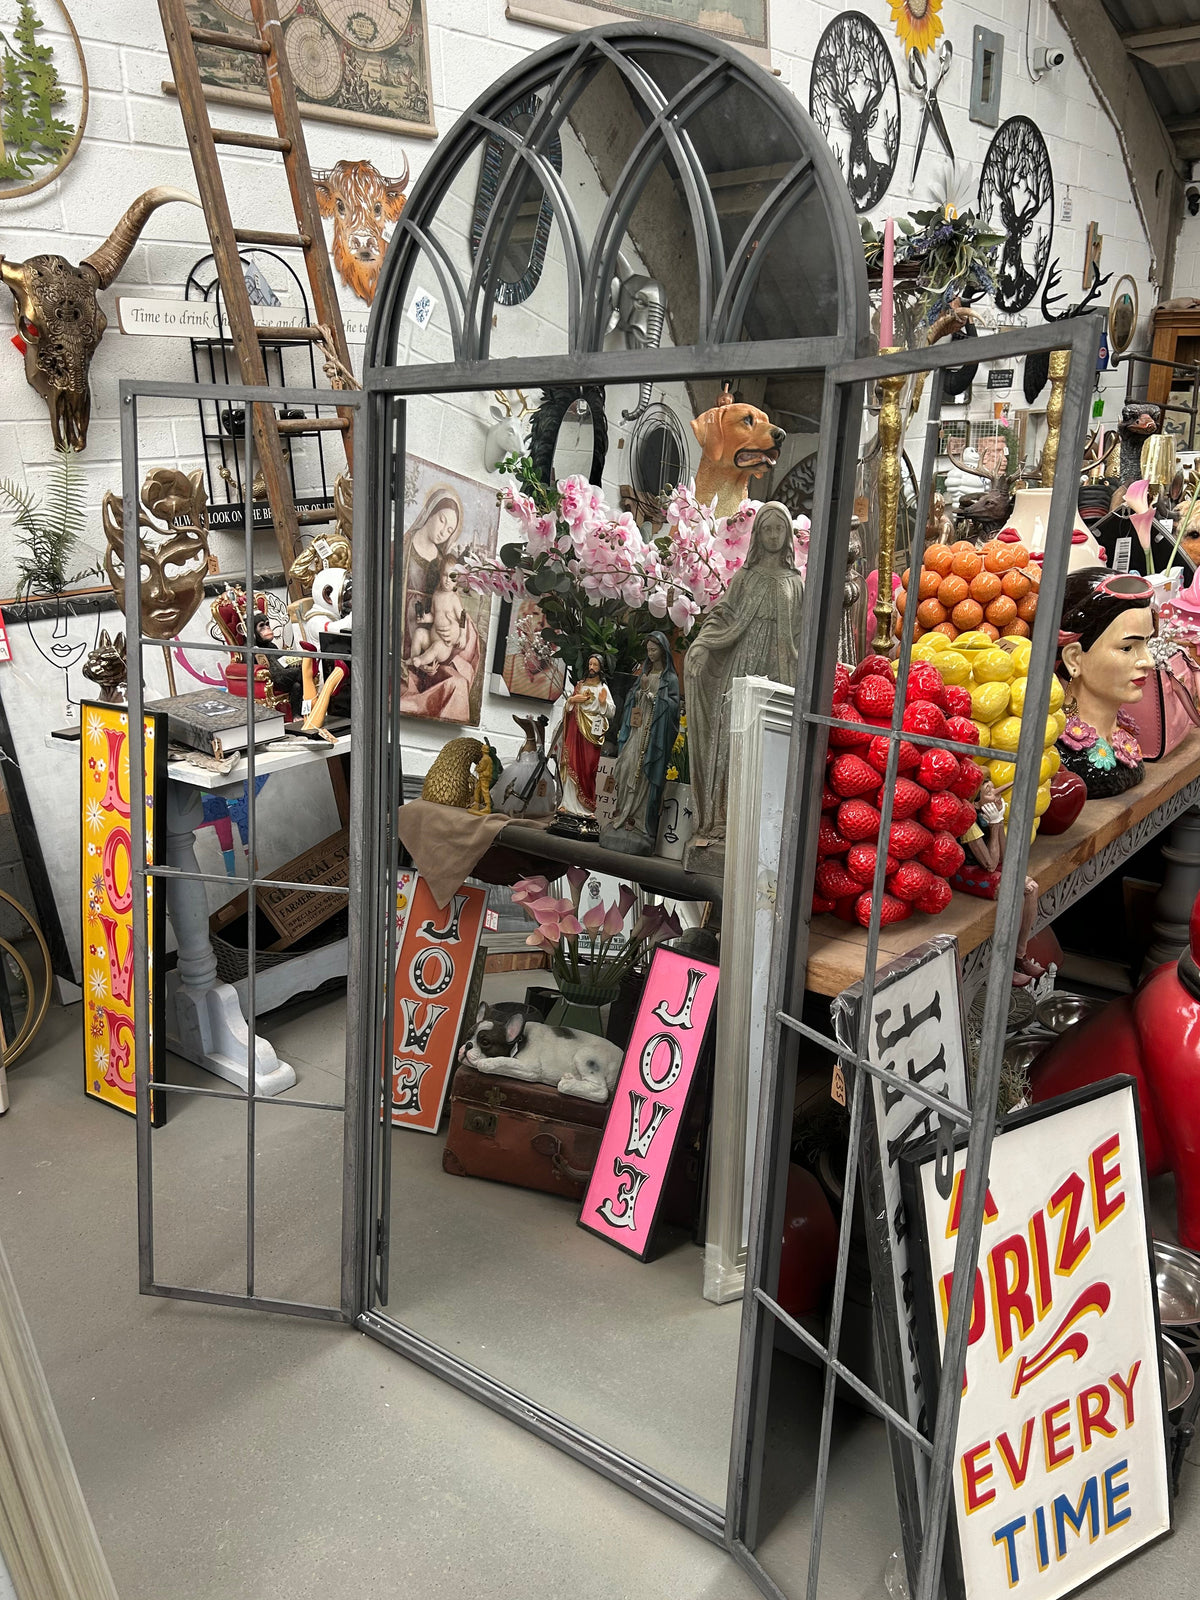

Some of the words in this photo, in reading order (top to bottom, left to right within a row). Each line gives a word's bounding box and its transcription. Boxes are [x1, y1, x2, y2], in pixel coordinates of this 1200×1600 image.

[131, 308, 161, 323] Time
[164, 311, 176, 323] to
[179, 309, 213, 328] drink
[208, 511, 231, 524] LOOK
[961, 1360, 1142, 1516] EVERY
[992, 1458, 1133, 1589] TIME
